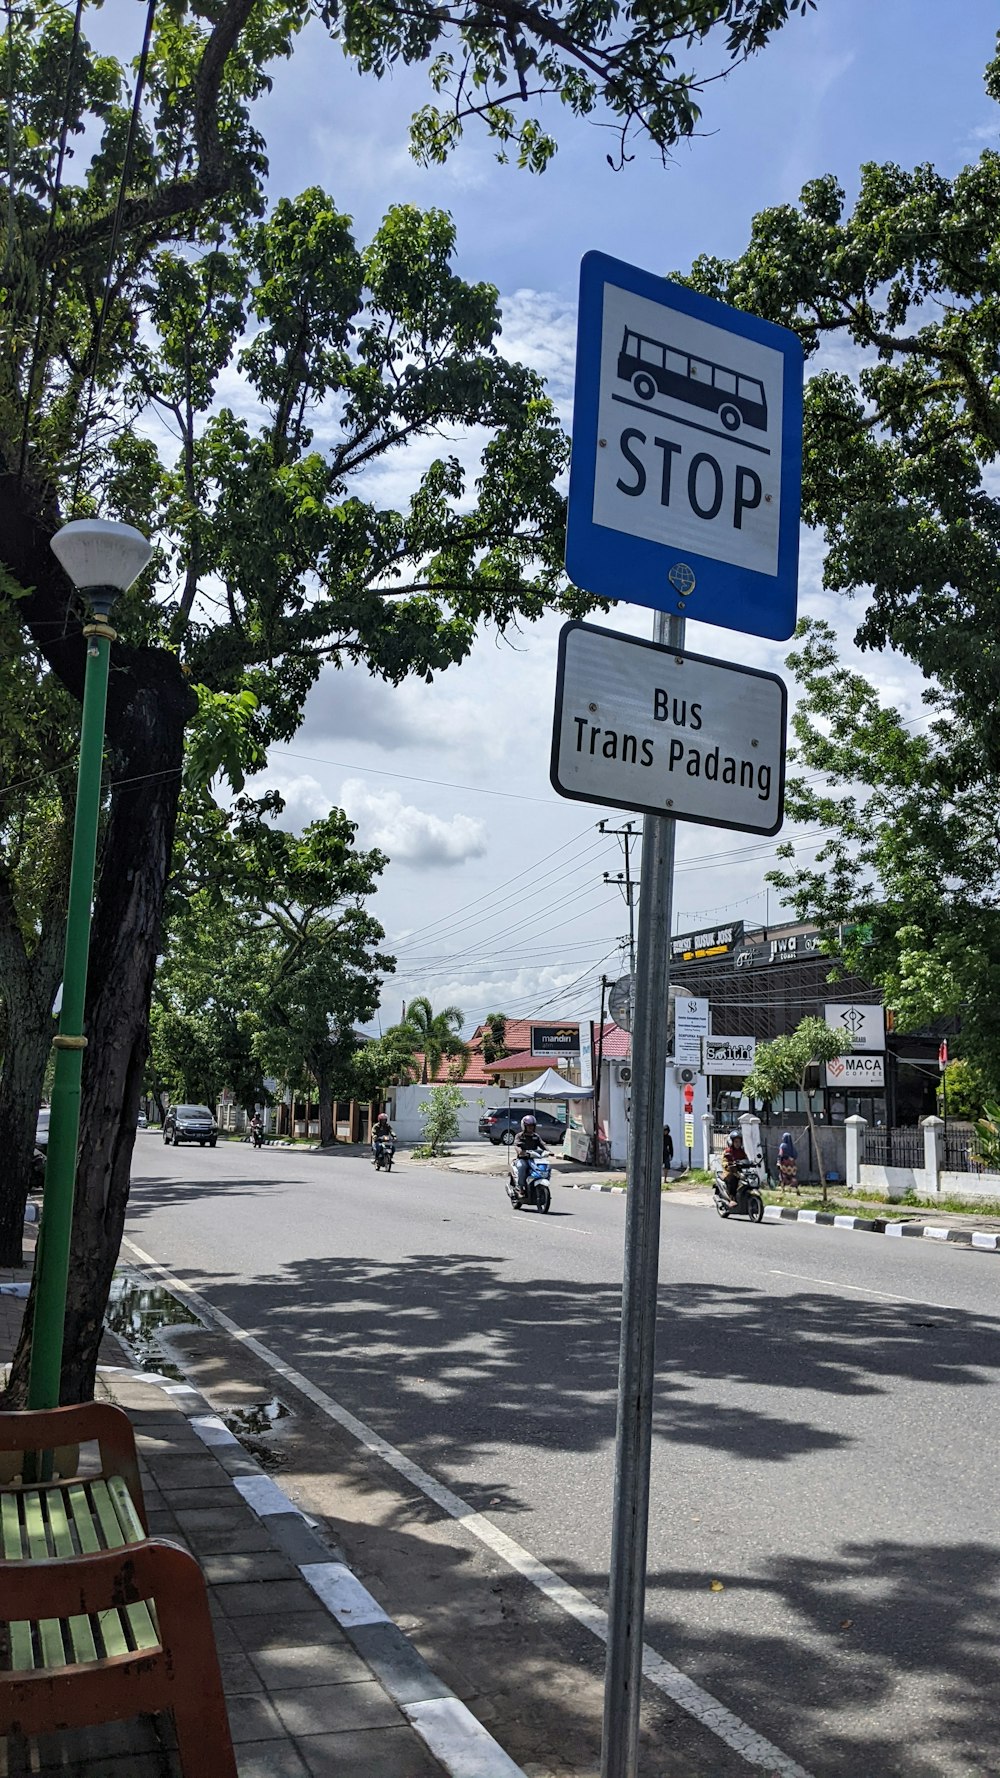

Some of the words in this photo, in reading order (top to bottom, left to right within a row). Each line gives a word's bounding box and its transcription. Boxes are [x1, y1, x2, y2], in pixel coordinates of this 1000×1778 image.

[616, 427, 762, 529] STOP
[653, 688, 702, 730] Bus
[574, 717, 654, 767] Trans
[669, 739, 772, 801] Padang
[694, 932, 715, 950] RUSUK
[716, 928, 733, 945] JOSS
[541, 1034, 572, 1043] mandiri
[846, 1059, 882, 1070] MACA
